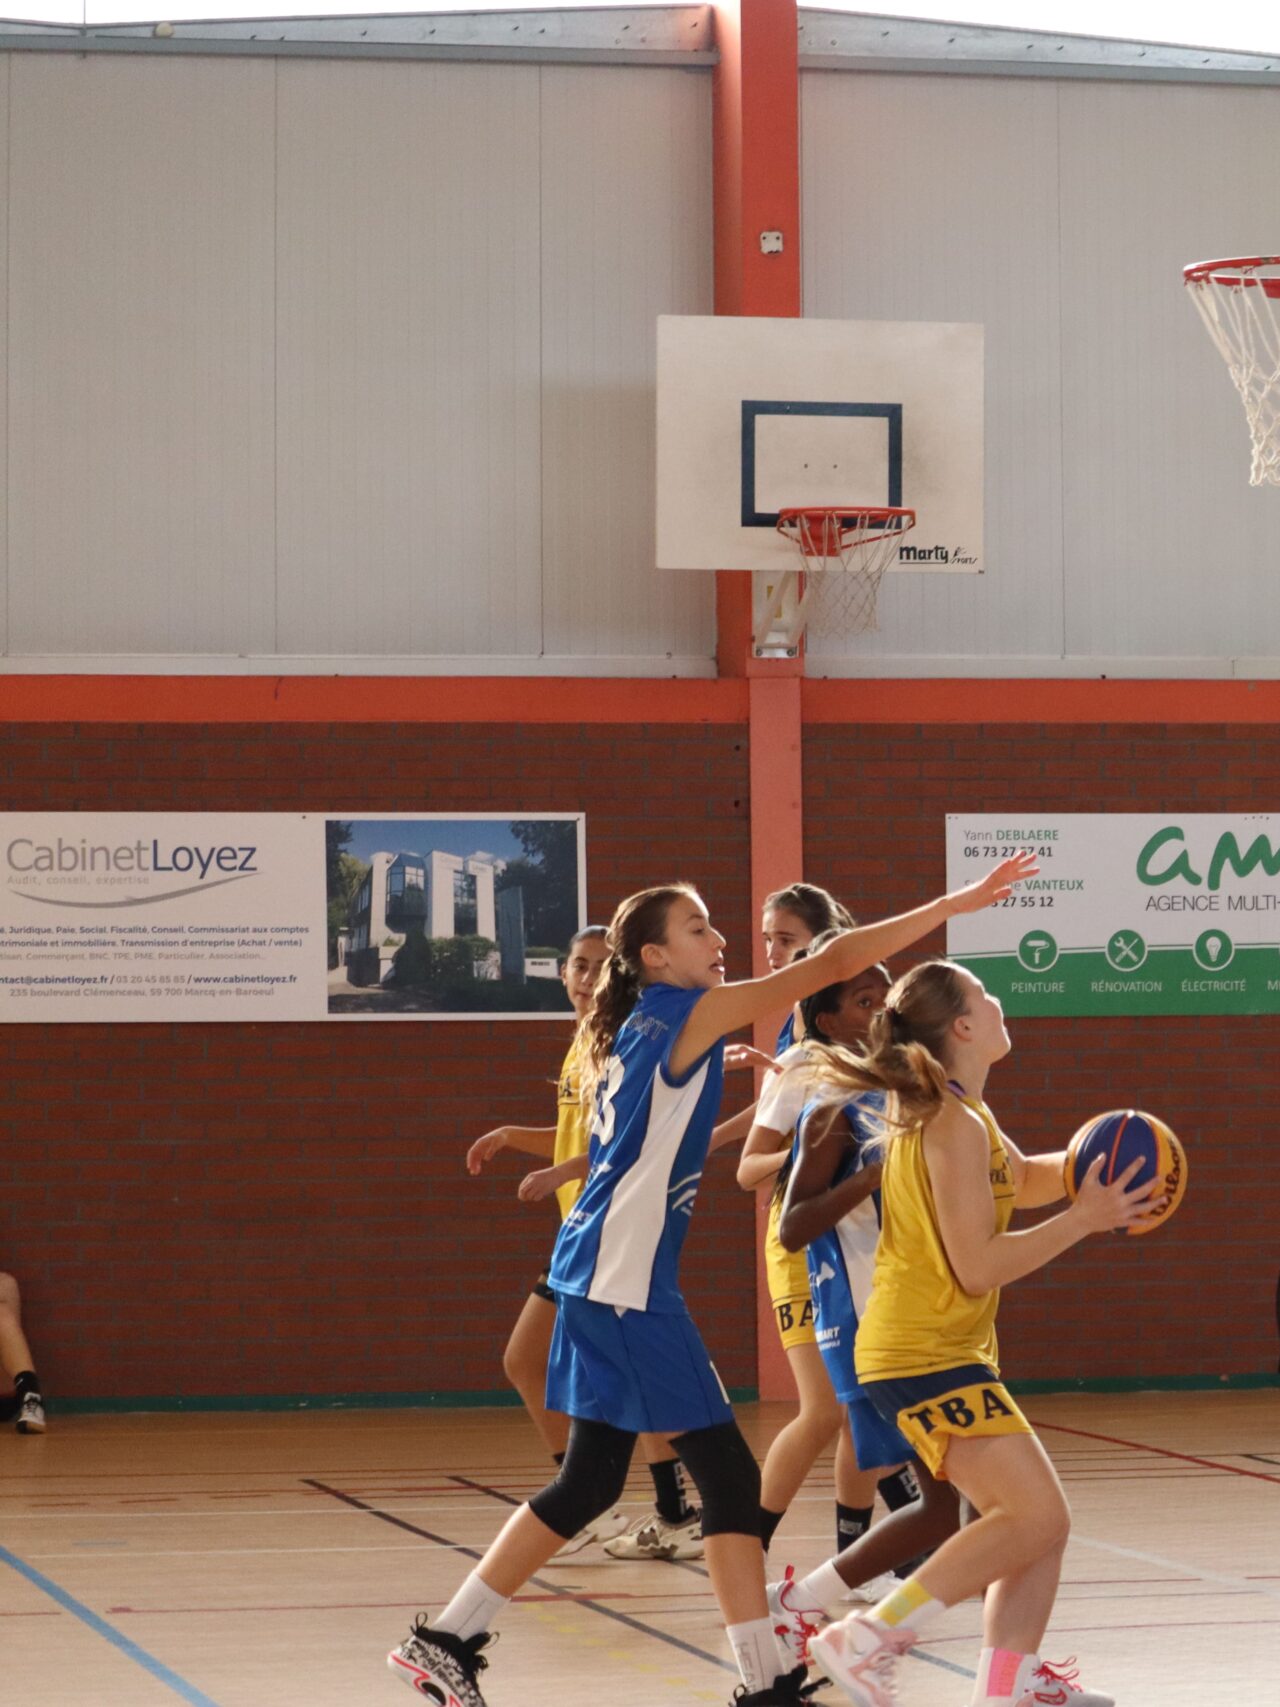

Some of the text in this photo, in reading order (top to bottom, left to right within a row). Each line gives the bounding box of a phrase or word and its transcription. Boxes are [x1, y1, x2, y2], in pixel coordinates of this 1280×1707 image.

[963, 829, 1059, 841] Yann DEBLAERE
[963, 846, 980, 858] 06
[983, 846, 998, 857] 73
[1001, 846, 1015, 857] 27
[1038, 846, 1053, 857] 41
[95, 875, 150, 886] expertise
[1024, 879, 1084, 891] VANTEUX
[1002, 896, 1016, 908] 27
[1020, 896, 1036, 908] 55
[1039, 896, 1054, 908] 12
[1145, 895, 1220, 912] AGENCE
[187, 925, 250, 934] Commissariat
[252, 926, 268, 934] aux
[270, 926, 310, 935] comptes
[49, 939, 59, 947] et
[120, 938, 180, 947] Transmission
[237, 938, 266, 948] (Achat
[273, 938, 303, 947] vente)
[130, 975, 143, 984] 20
[193, 974, 298, 985] www.cabinetloyez.fr
[1181, 978, 1247, 992] ÉLECTRICITÉ
[1011, 981, 1065, 993] PEINTURE
[1091, 979, 1163, 993] RÉNOVATION
[10, 988, 28, 997] 235
[30, 988, 81, 997] boulevard
[907, 1389, 1014, 1434] TBA
